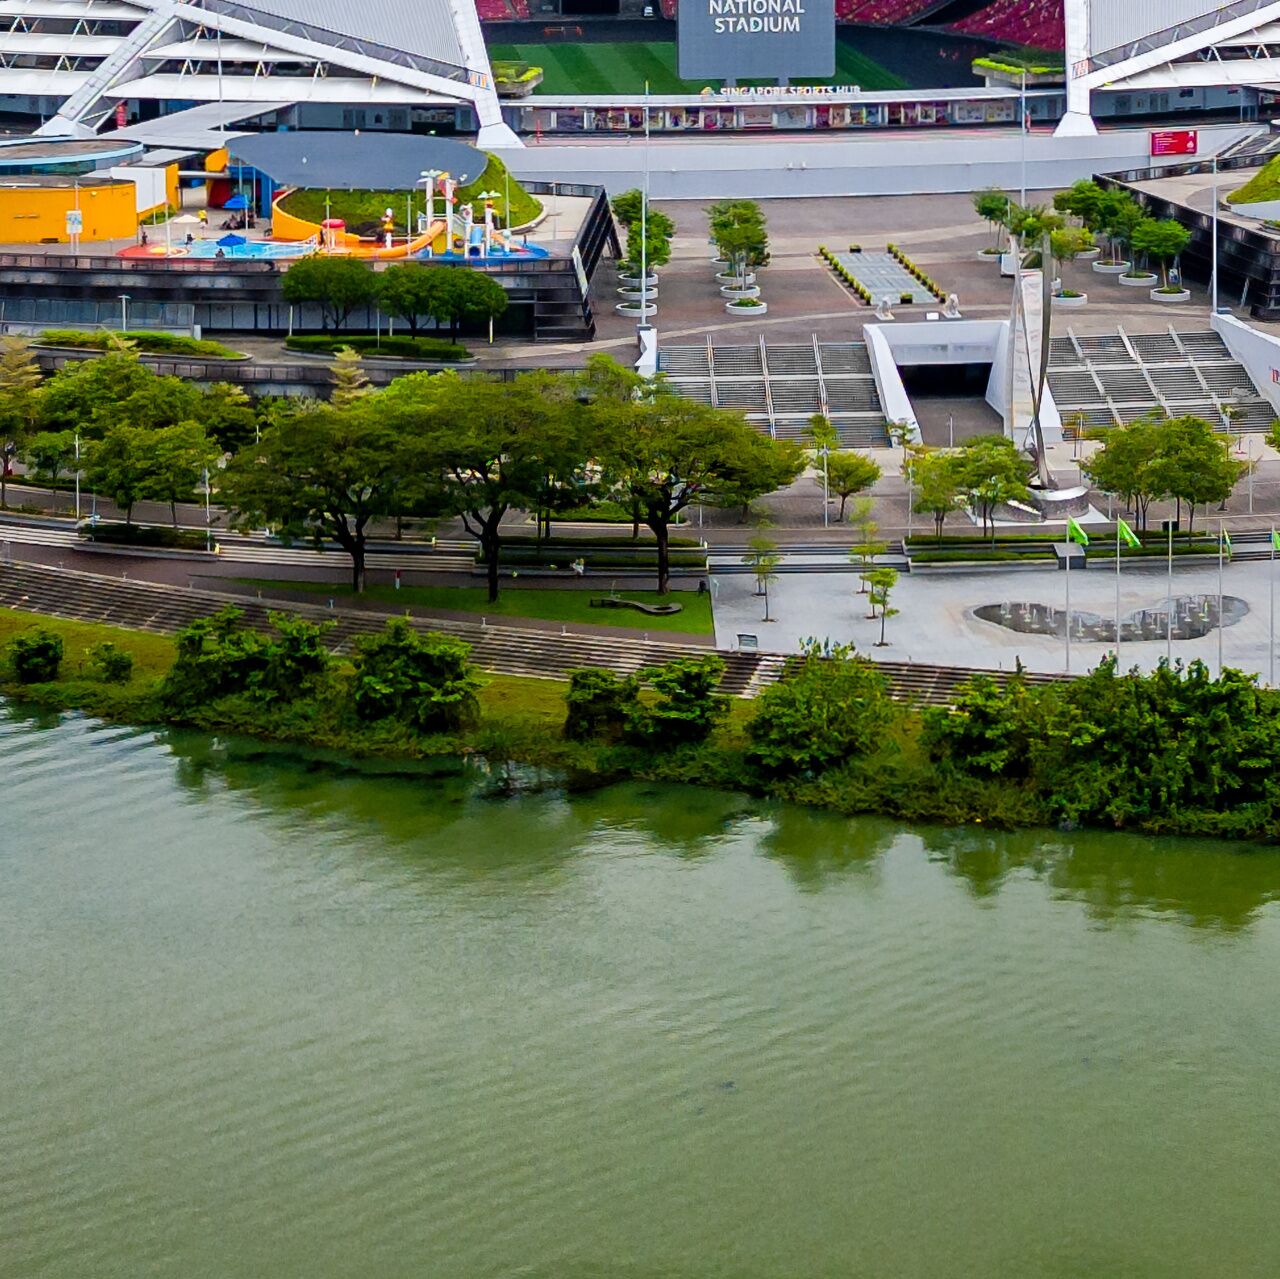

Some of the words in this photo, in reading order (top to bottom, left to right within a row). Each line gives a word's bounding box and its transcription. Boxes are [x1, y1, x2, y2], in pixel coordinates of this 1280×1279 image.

[714, 16, 800, 33] STADIUM
[720, 86, 786, 97] SINGAPORE
[787, 86, 834, 96] SPORTS
[836, 85, 861, 95] HUB
